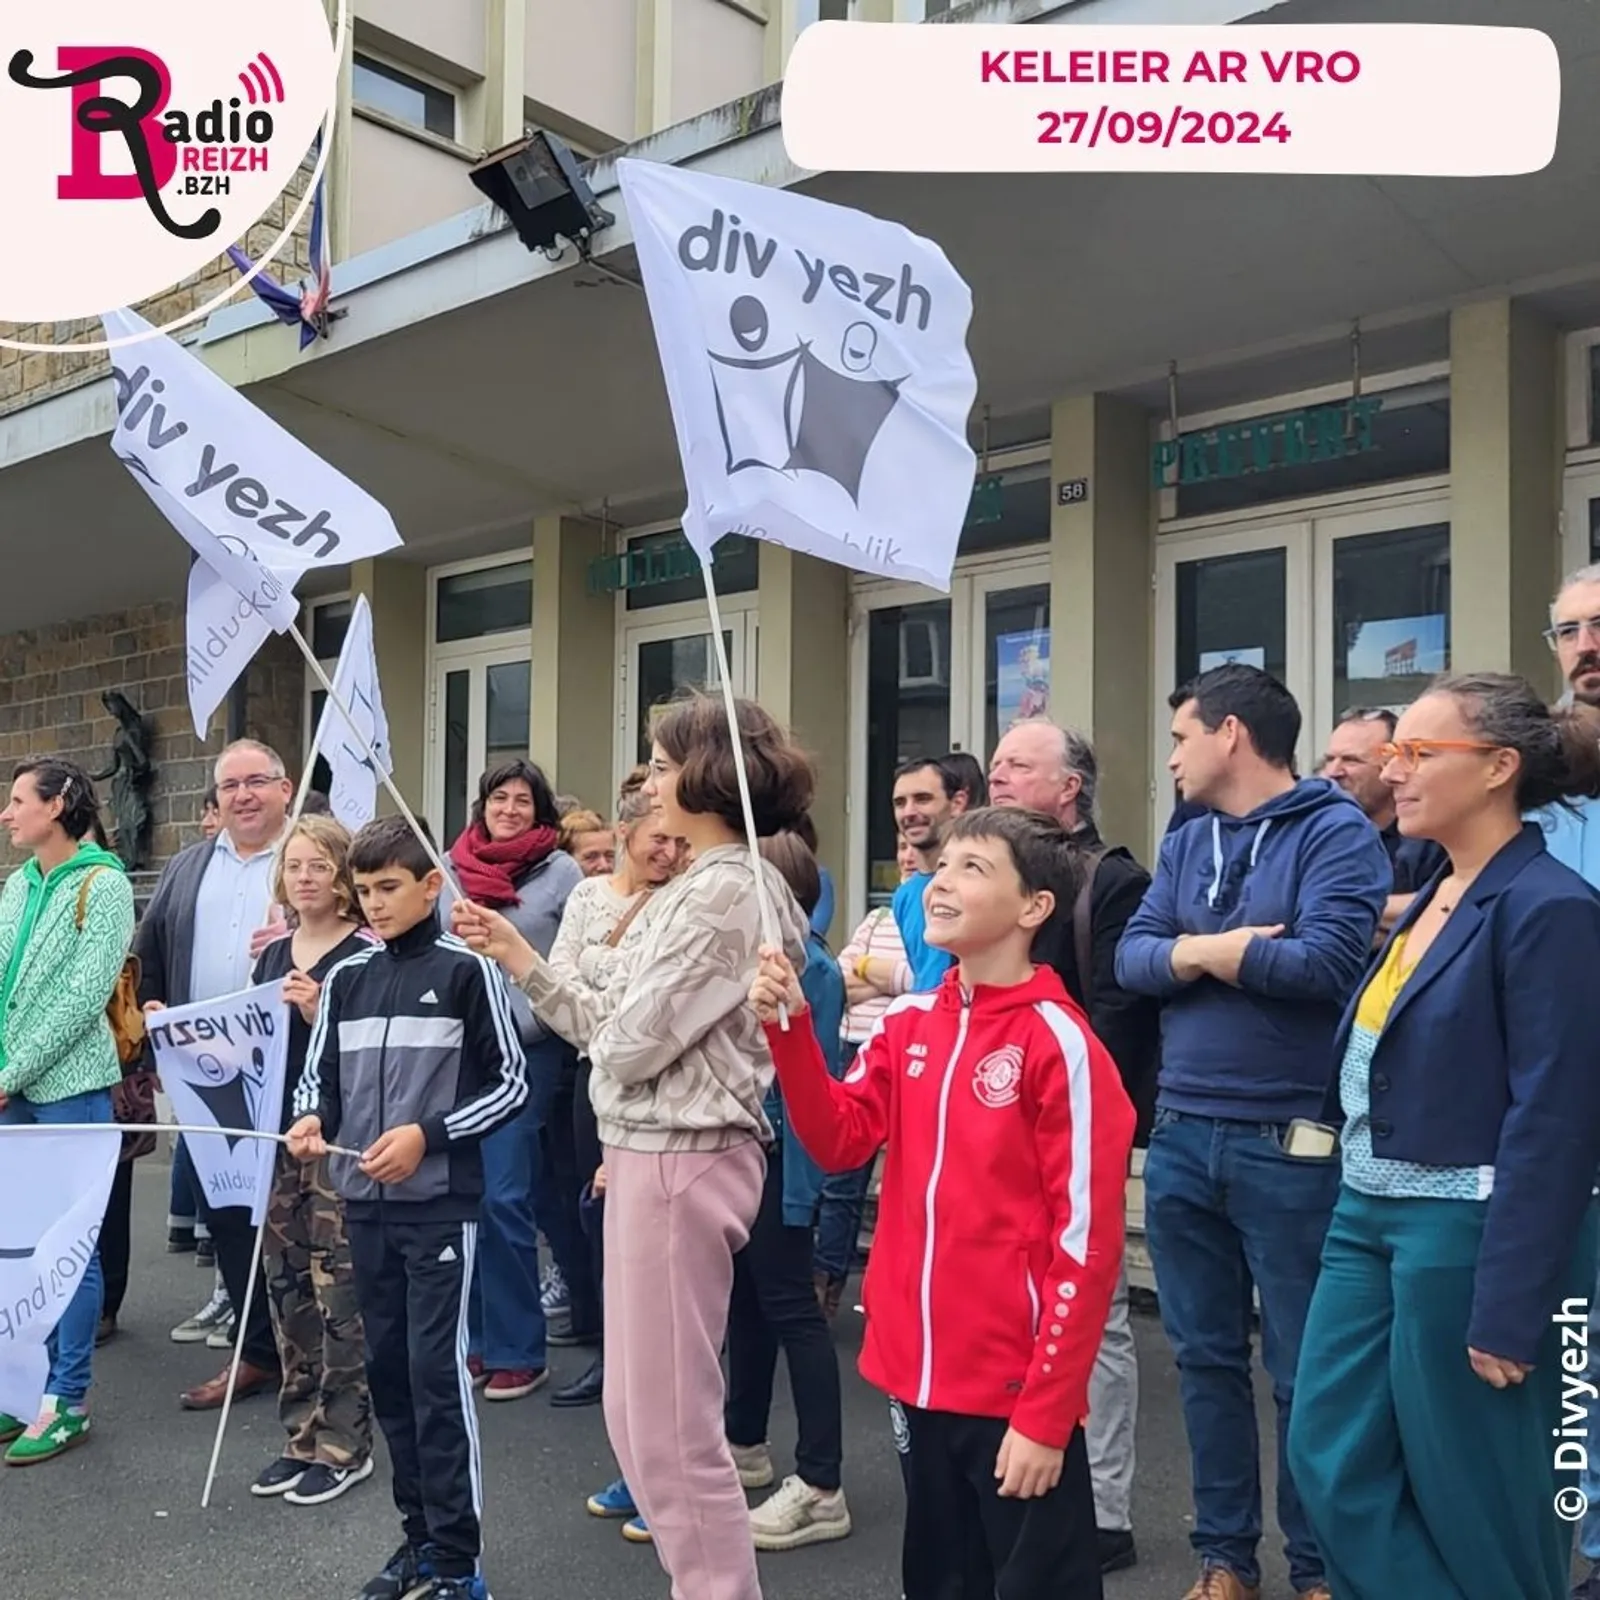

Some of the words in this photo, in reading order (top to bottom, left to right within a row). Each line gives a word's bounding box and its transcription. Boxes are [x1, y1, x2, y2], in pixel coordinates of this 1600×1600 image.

[678, 209, 777, 277] div
[794, 249, 932, 331] yezh
[184, 444, 340, 558] yezh
[1061, 483, 1083, 501] 58
